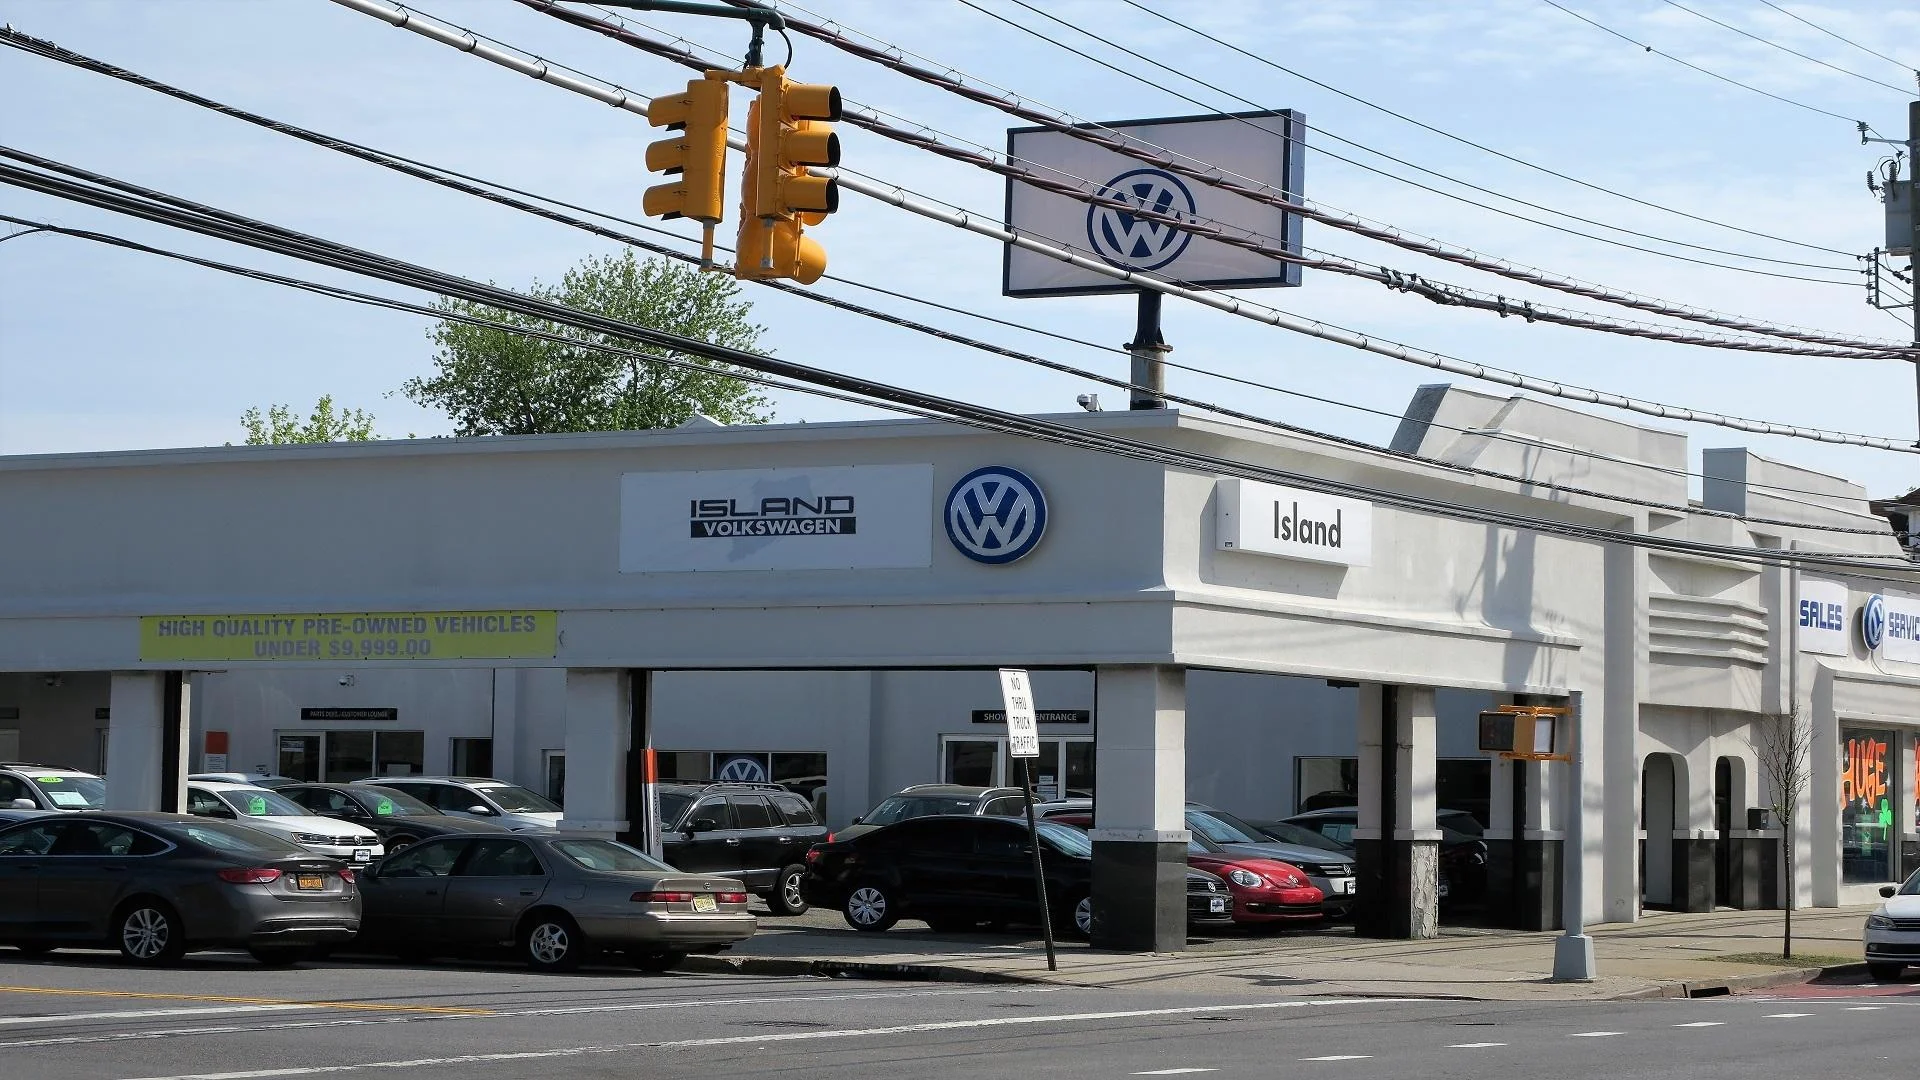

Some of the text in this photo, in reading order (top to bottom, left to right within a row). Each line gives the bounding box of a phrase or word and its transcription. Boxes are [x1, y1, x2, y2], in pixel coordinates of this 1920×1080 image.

[690, 495, 855, 518] ISLAND
[951, 474, 1035, 556] VW
[703, 518, 841, 536] VOLKSWAGEN
[1274, 500, 1341, 548] Island
[1800, 600, 1842, 631] SALES
[158, 615, 536, 637] HIGH QUALITY PRE-OWNED VEHICLES
[254, 639, 431, 658] UNDER $9,999.00
[1011, 677, 1021, 690] NO
[1012, 697, 1027, 710] THRU
[1012, 716, 1032, 730] TRUCK
[1012, 736, 1036, 749] TRAFFIC
[1840, 737, 1887, 810] HUGE
